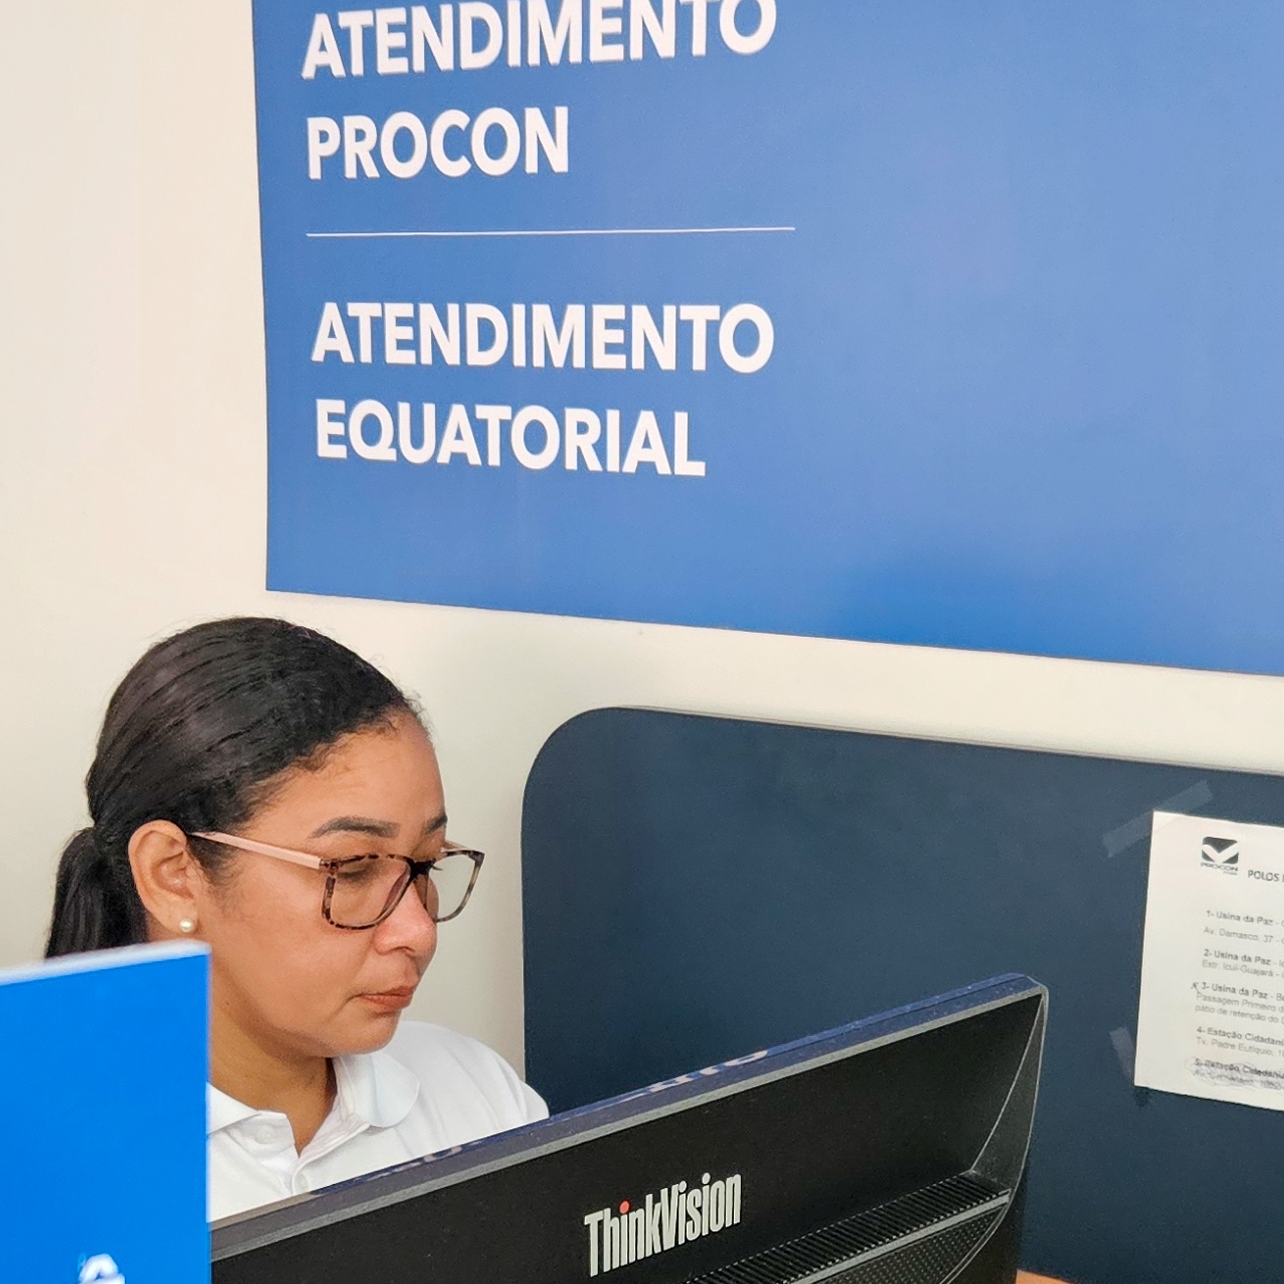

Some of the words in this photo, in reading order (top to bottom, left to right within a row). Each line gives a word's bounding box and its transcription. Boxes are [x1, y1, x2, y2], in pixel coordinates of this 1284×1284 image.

[301, 0, 778, 79] ATENDIMENTO
[305, 106, 569, 180] PROCON
[311, 302, 775, 374] ATENDIMENTO
[315, 398, 706, 477] EQUATORIAL
[1248, 870, 1280, 882] POLOS
[1257, 916, 1273, 926] Paz
[1252, 989, 1268, 999] Paz
[1255, 956, 1271, 966] Paz
[584, 1172, 742, 1277] ThinkVision
